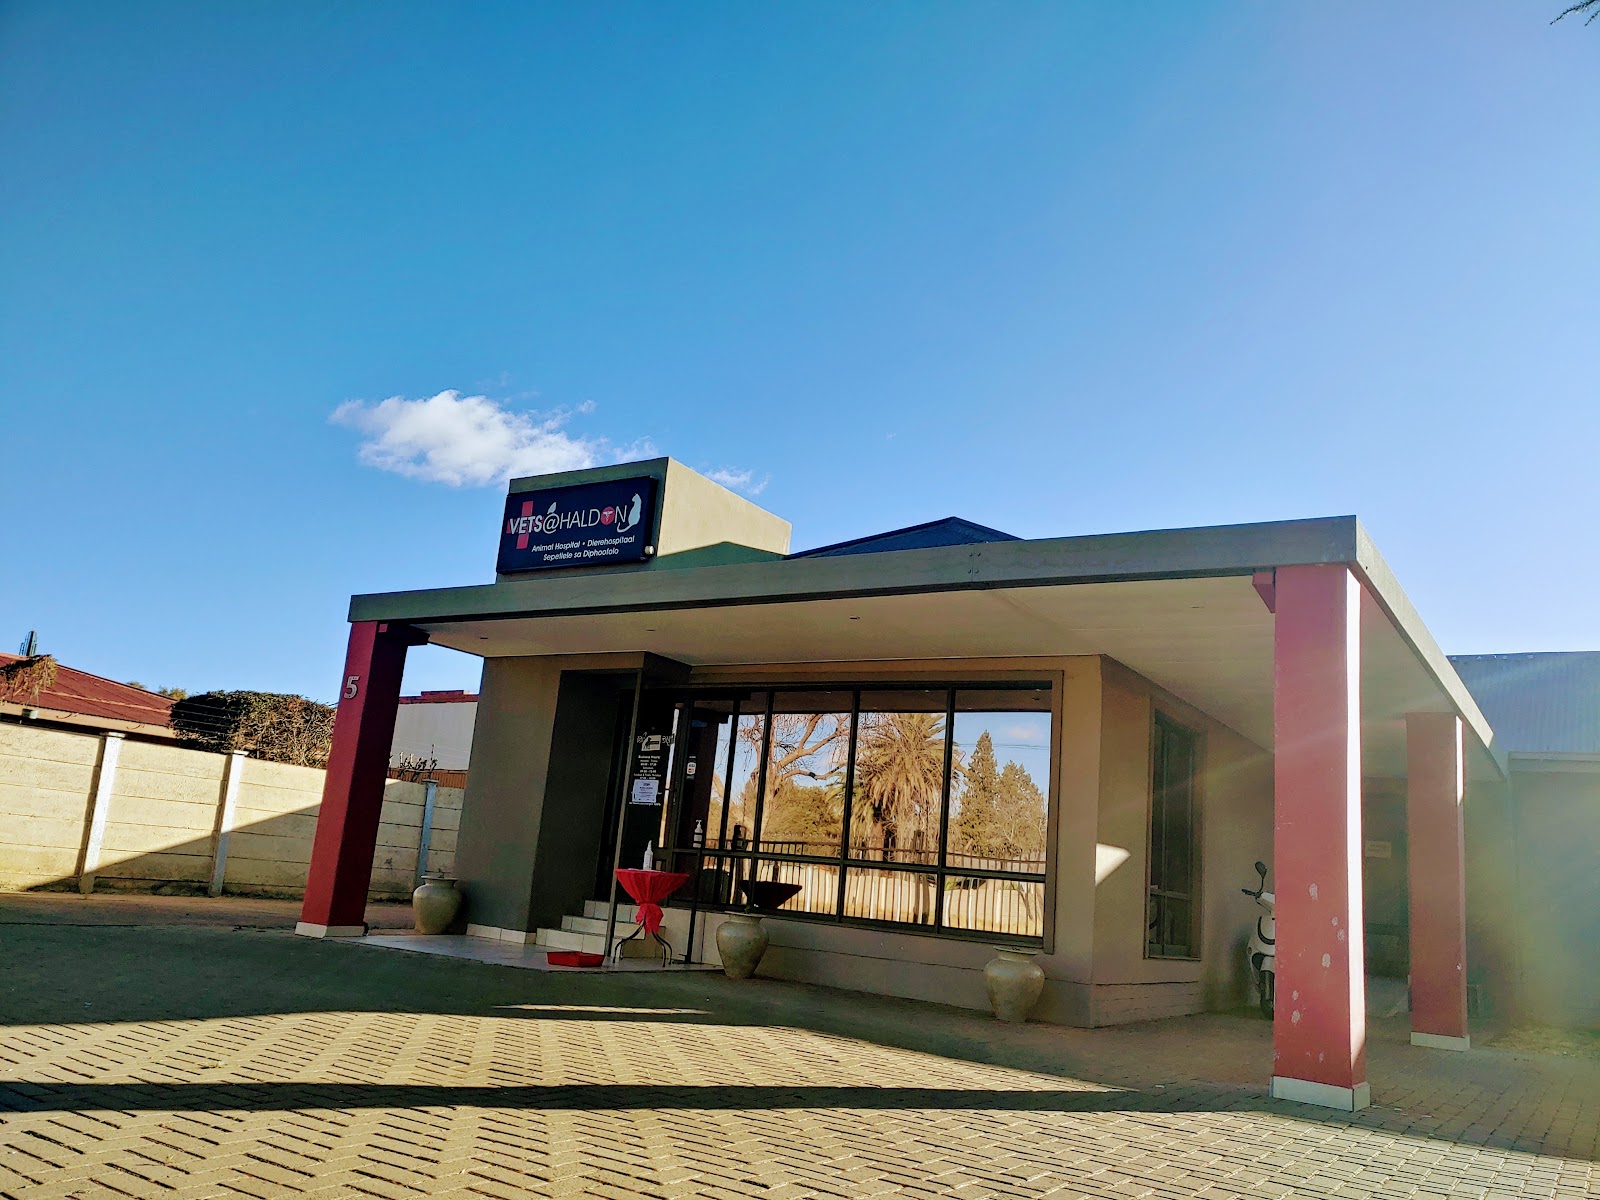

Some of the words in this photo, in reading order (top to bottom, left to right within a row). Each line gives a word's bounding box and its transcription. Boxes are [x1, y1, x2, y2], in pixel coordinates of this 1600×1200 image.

[531, 543, 554, 553] Animal
[554, 540, 581, 551] Hospital
[587, 535, 636, 547] Dierehospitaal
[543, 552, 573, 562] Sepetlele
[582, 547, 620, 559] Diphoofolo
[344, 675, 360, 699] 5
